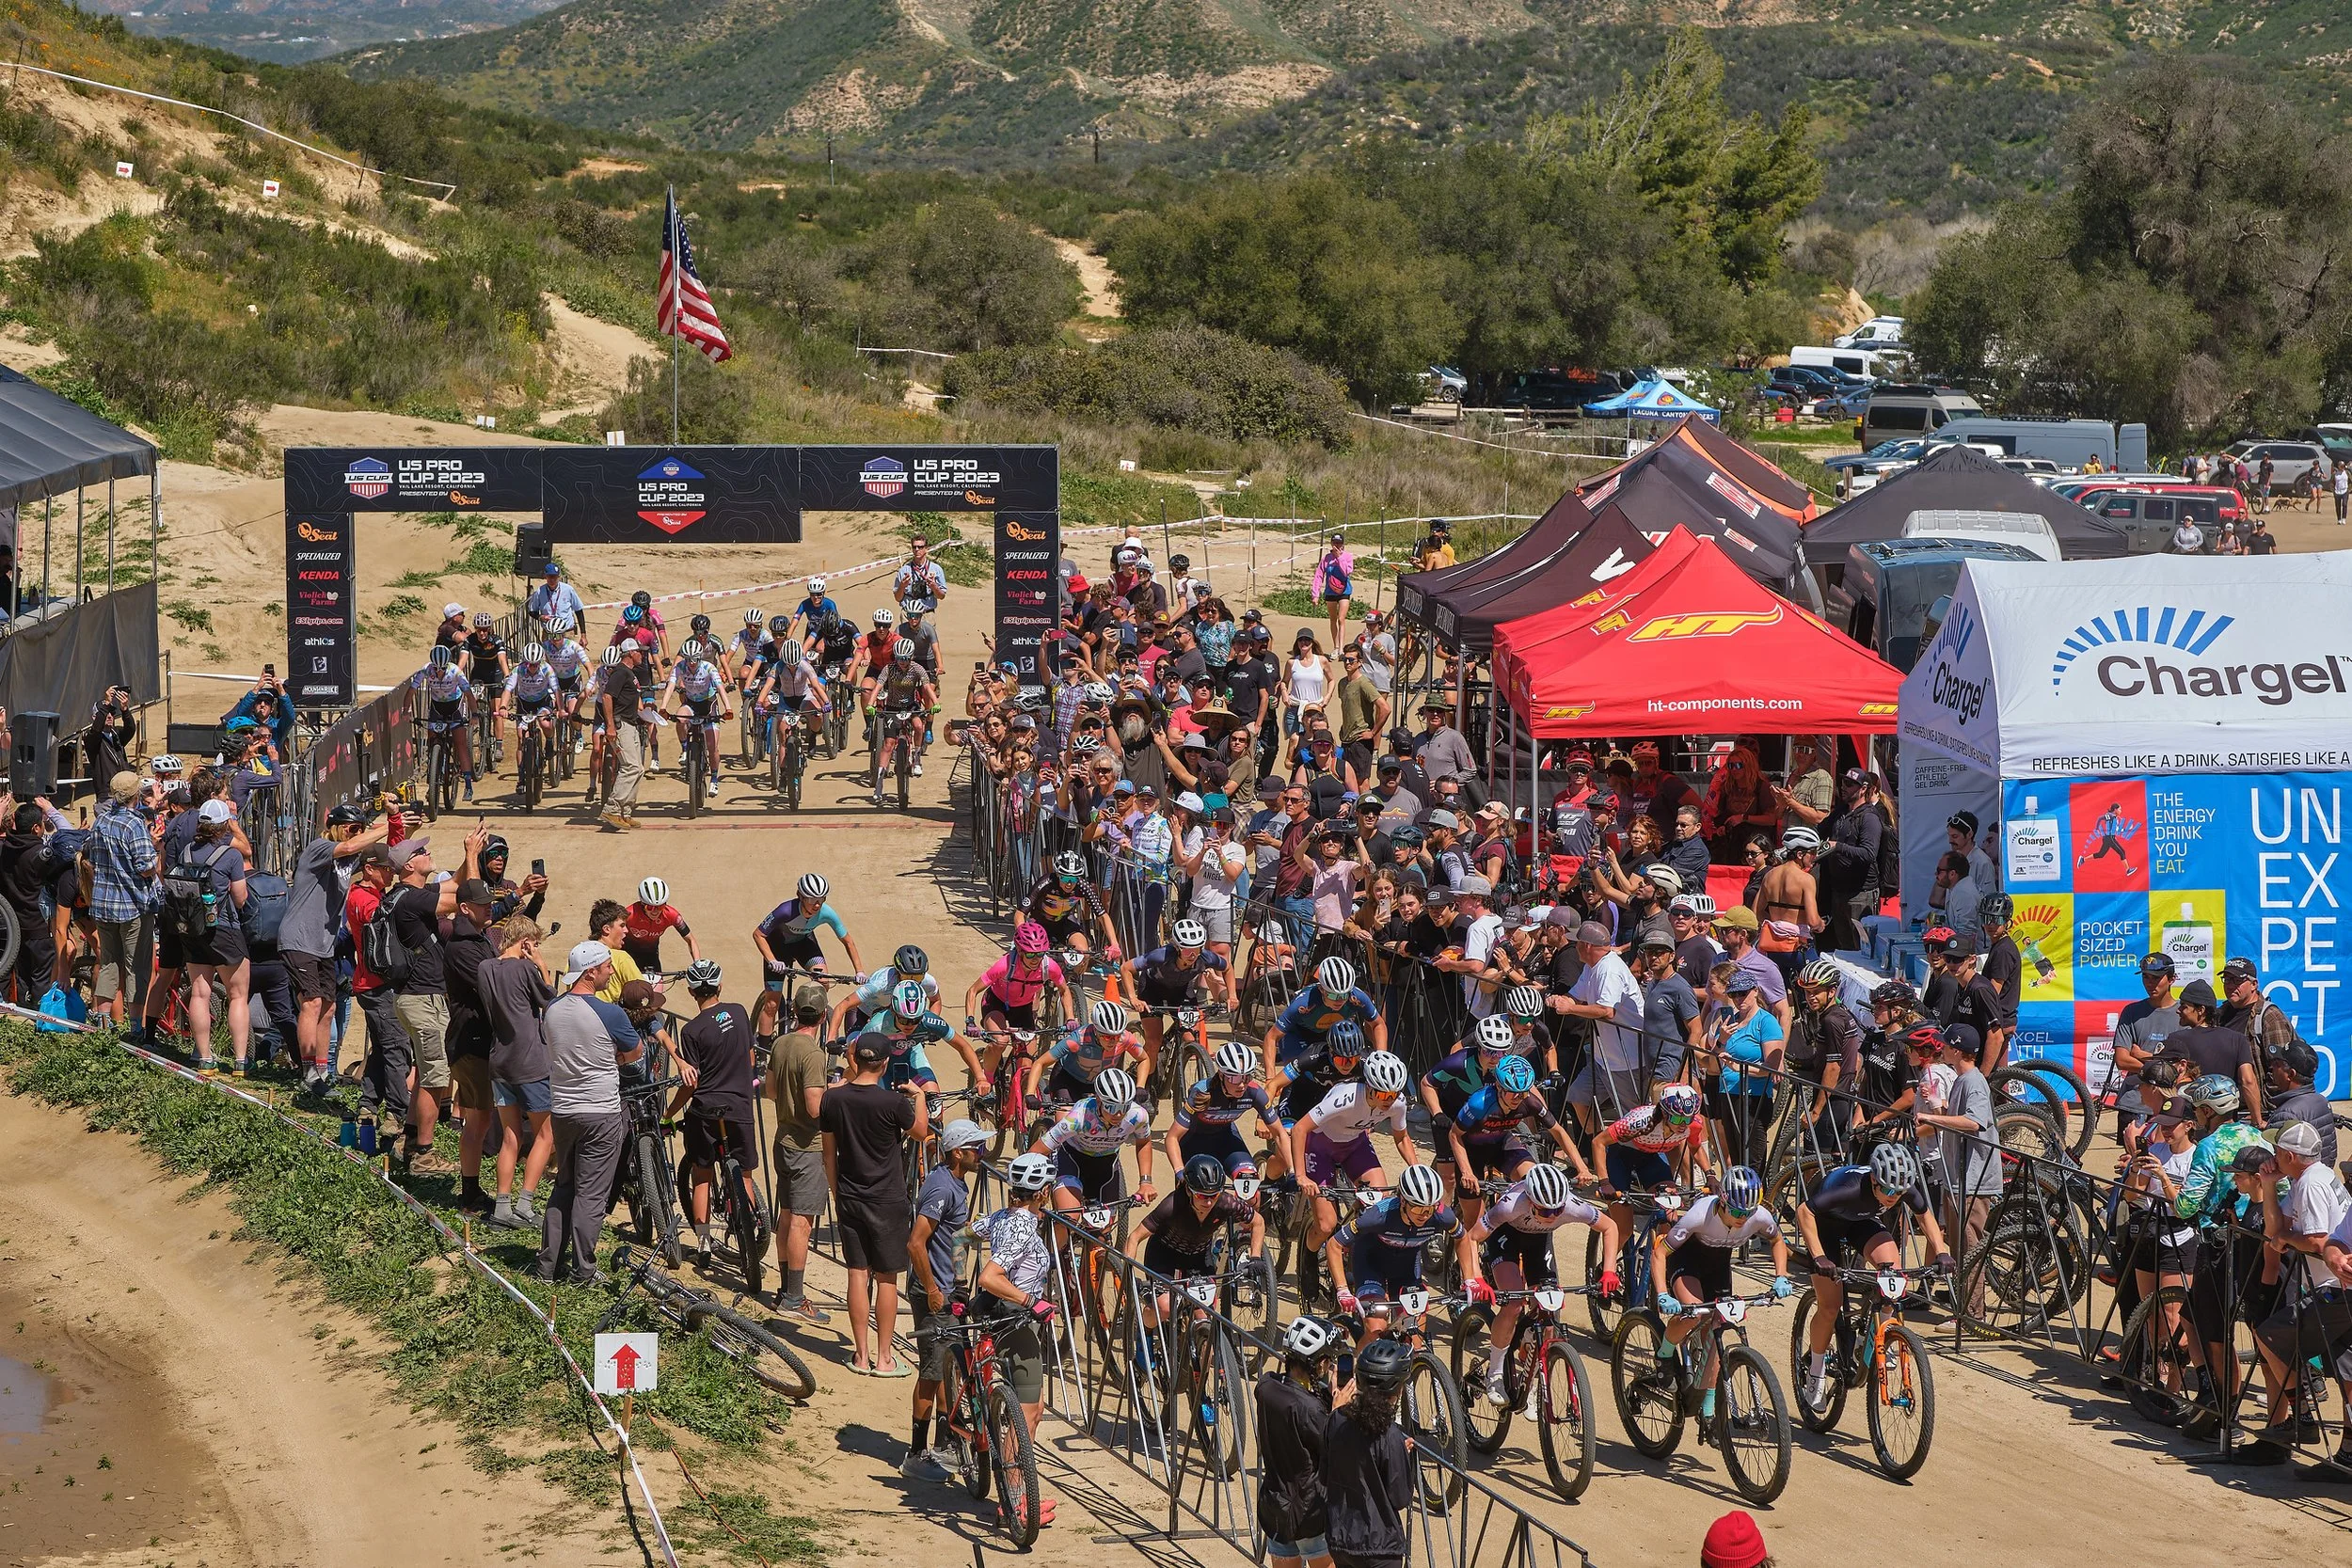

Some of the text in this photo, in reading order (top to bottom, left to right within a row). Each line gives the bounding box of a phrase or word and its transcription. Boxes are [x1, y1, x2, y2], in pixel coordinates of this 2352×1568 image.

[399, 460, 463, 470] US PRO
[914, 459, 977, 469] US PRO
[399, 473, 485, 483] CUP 2023
[914, 472, 1000, 483] CUP 2023
[639, 483, 688, 492] US PRO
[639, 494, 705, 502] CUP 2023
[295, 552, 342, 561] SPECIALIZED
[298, 571, 340, 580] KENDA
[1007, 570, 1048, 579] KENDA
[295, 616, 343, 626] ESIgrips.com
[1629, 604, 1783, 642] HT
[2097, 655, 2346, 705] Chargel
[1932, 661, 1988, 725] Chargel
[1543, 701, 1596, 721] HT
[1647, 696, 1803, 714] ht-components.com
[2032, 751, 2350, 770] REFRESHES LIKE A DRINK. SATISFIES LIKE A
[1915, 764, 1968, 774] CAFFEINE-FREE
[1915, 773, 1947, 782] ATHLETIC
[1915, 779, 1950, 788] GEL DRINK
[2153, 792, 2184, 807] THE
[2153, 808, 2216, 824] ENERGY
[2251, 788, 2340, 844] UN
[2154, 825, 2202, 841] DRINK
[2018, 836, 2053, 847] Chargel
[1207, 852, 1218, 861] TRA
[2155, 843, 2187, 857] YOU
[2156, 859, 2185, 874] EAT.
[2259, 852, 2339, 909] EX
[2080, 921, 2143, 936] POCKET
[2080, 938, 2125, 952] SIZED
[2172, 943, 2207, 953] Chargel
[2262, 917, 2337, 973] PE
[1069, 954, 1078, 962] 21
[2079, 954, 2141, 968] POWER.
[927, 1016, 946, 1028] WTB
[1183, 1011, 1194, 1023] 20
[2013, 1031, 2055, 1043] XCEL
[1333, 1093, 1355, 1110] Liv
[1243, 1180, 1250, 1194] 8
[1366, 1192, 1375, 1201] 9
[1090, 1212, 1105, 1224] 24
[1888, 1277, 1897, 1292] 6
[1198, 1286, 1207, 1301] 5
[1546, 1291, 1553, 1305] 1
[1410, 1293, 1420, 1309] 3
[1727, 1302, 1737, 1317] 2
